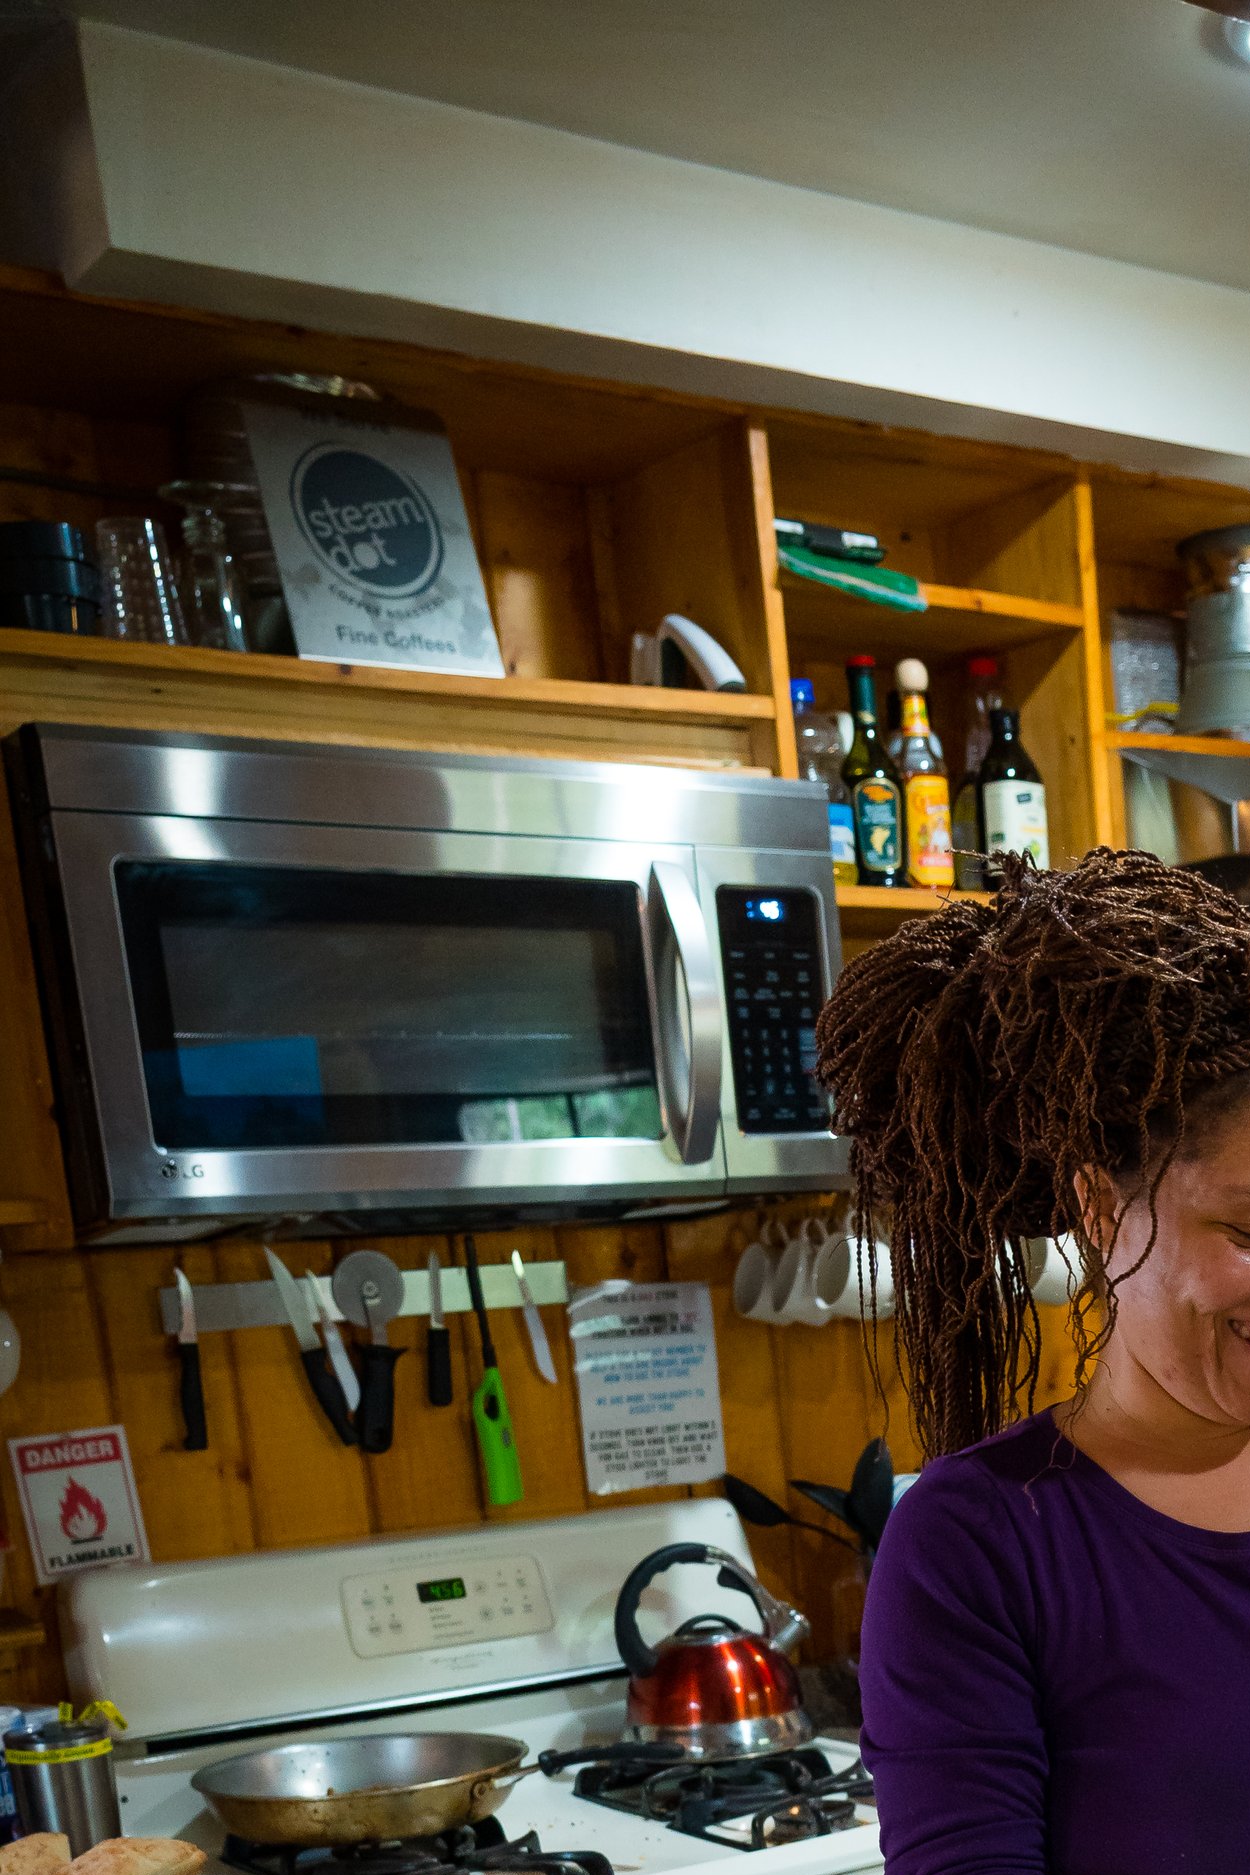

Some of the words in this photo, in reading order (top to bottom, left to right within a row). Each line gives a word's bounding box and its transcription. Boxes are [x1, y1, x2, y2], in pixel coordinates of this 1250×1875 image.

[308, 496, 425, 538] steam
[328, 531, 397, 571] dot
[335, 624, 380, 647] Fine
[383, 629, 458, 654] Coffees
[24, 1439, 114, 1468] DANGER
[49, 1543, 135, 1568] FLAMMABLE
